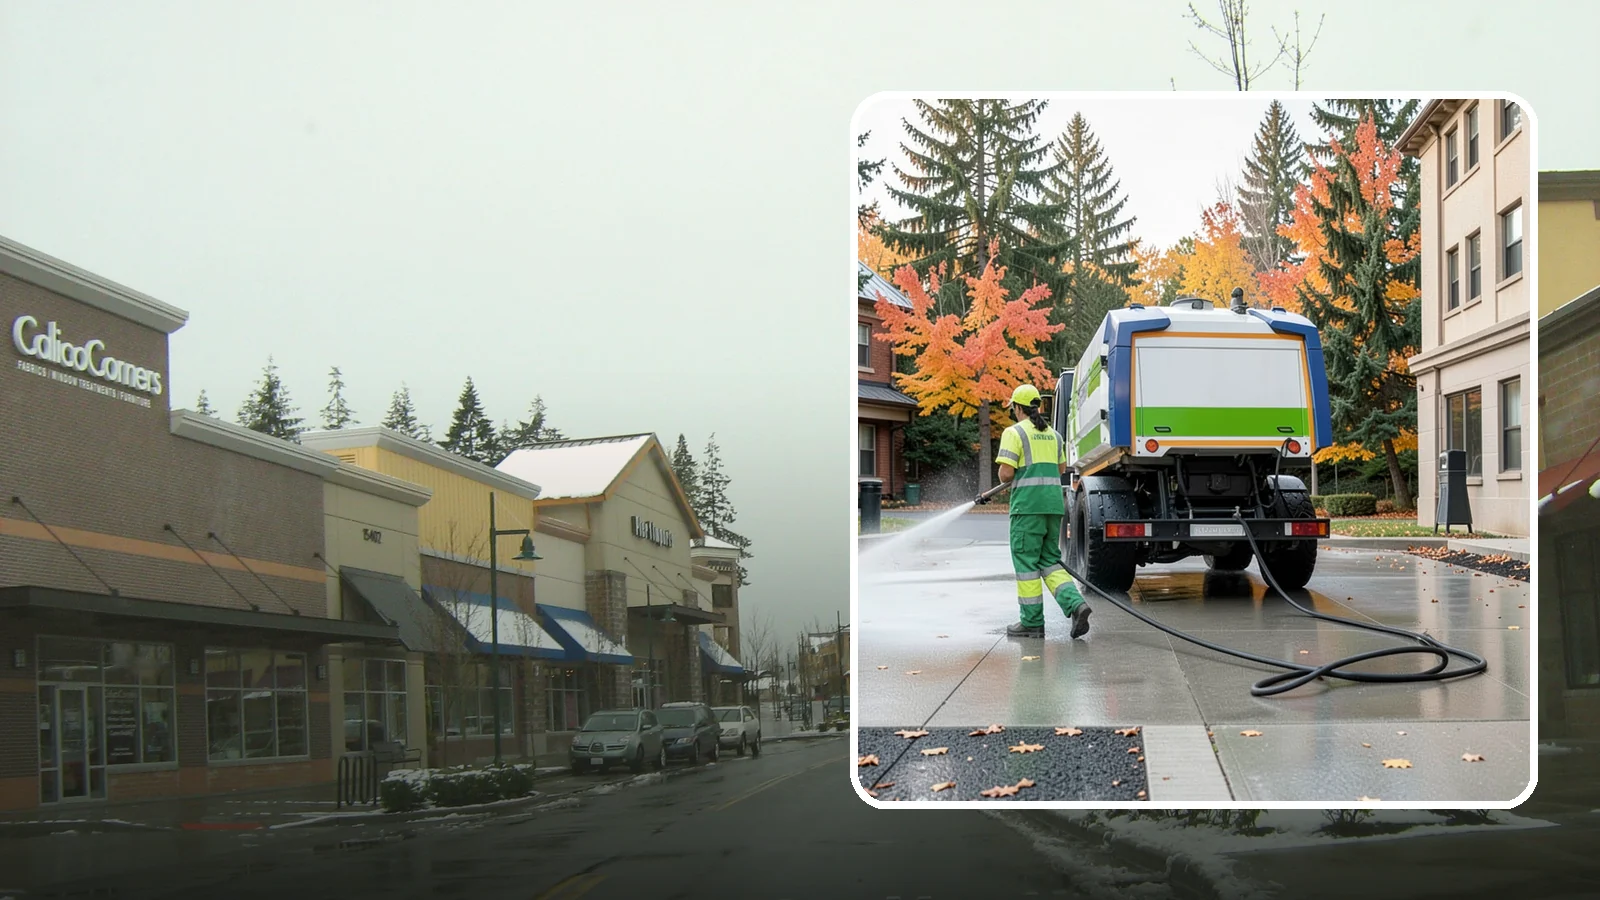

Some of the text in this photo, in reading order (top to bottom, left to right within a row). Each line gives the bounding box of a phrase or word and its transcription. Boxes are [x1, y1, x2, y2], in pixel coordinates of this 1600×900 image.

[17, 360, 46, 377] FABRICS
[51, 369, 78, 386] WINDOW
[78, 378, 116, 398] TREATMENTS
